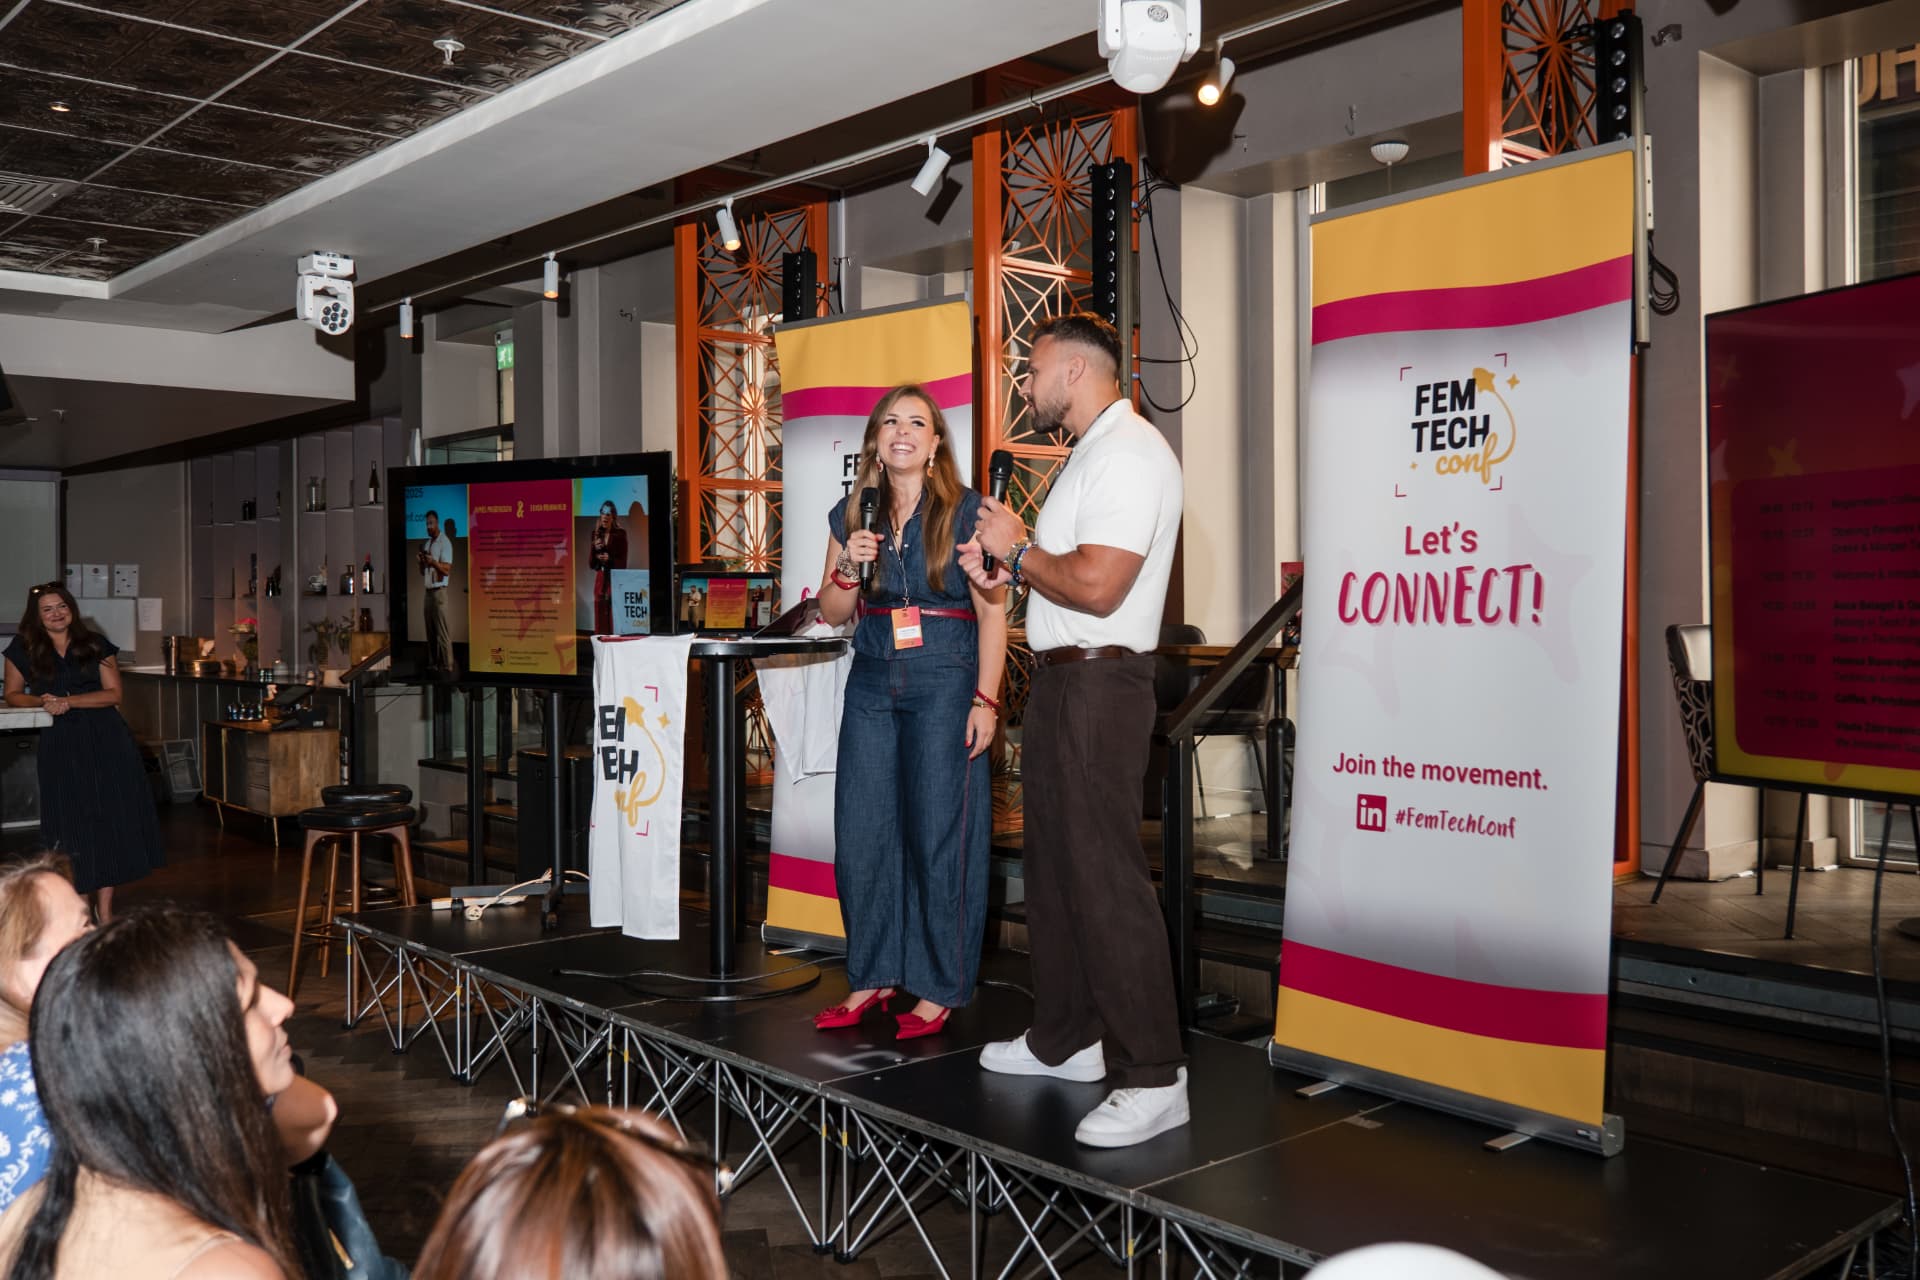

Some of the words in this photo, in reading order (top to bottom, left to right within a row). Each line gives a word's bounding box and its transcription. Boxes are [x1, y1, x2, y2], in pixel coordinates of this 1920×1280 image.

[1415, 378, 1477, 416] FEM
[1411, 414, 1490, 453] TECH
[1435, 432, 1499, 484] conf
[1404, 522, 1478, 556] Let’s
[624, 592, 643, 605] FEM
[1338, 563, 1544, 626] CONNECT!
[624, 606, 647, 619] TECH
[1333, 753, 1376, 775] Join
[1382, 756, 1416, 779] the
[1421, 764, 1548, 790] movement.
[1360, 798, 1382, 827] in
[1396, 808, 1515, 838] #FemTechConf
